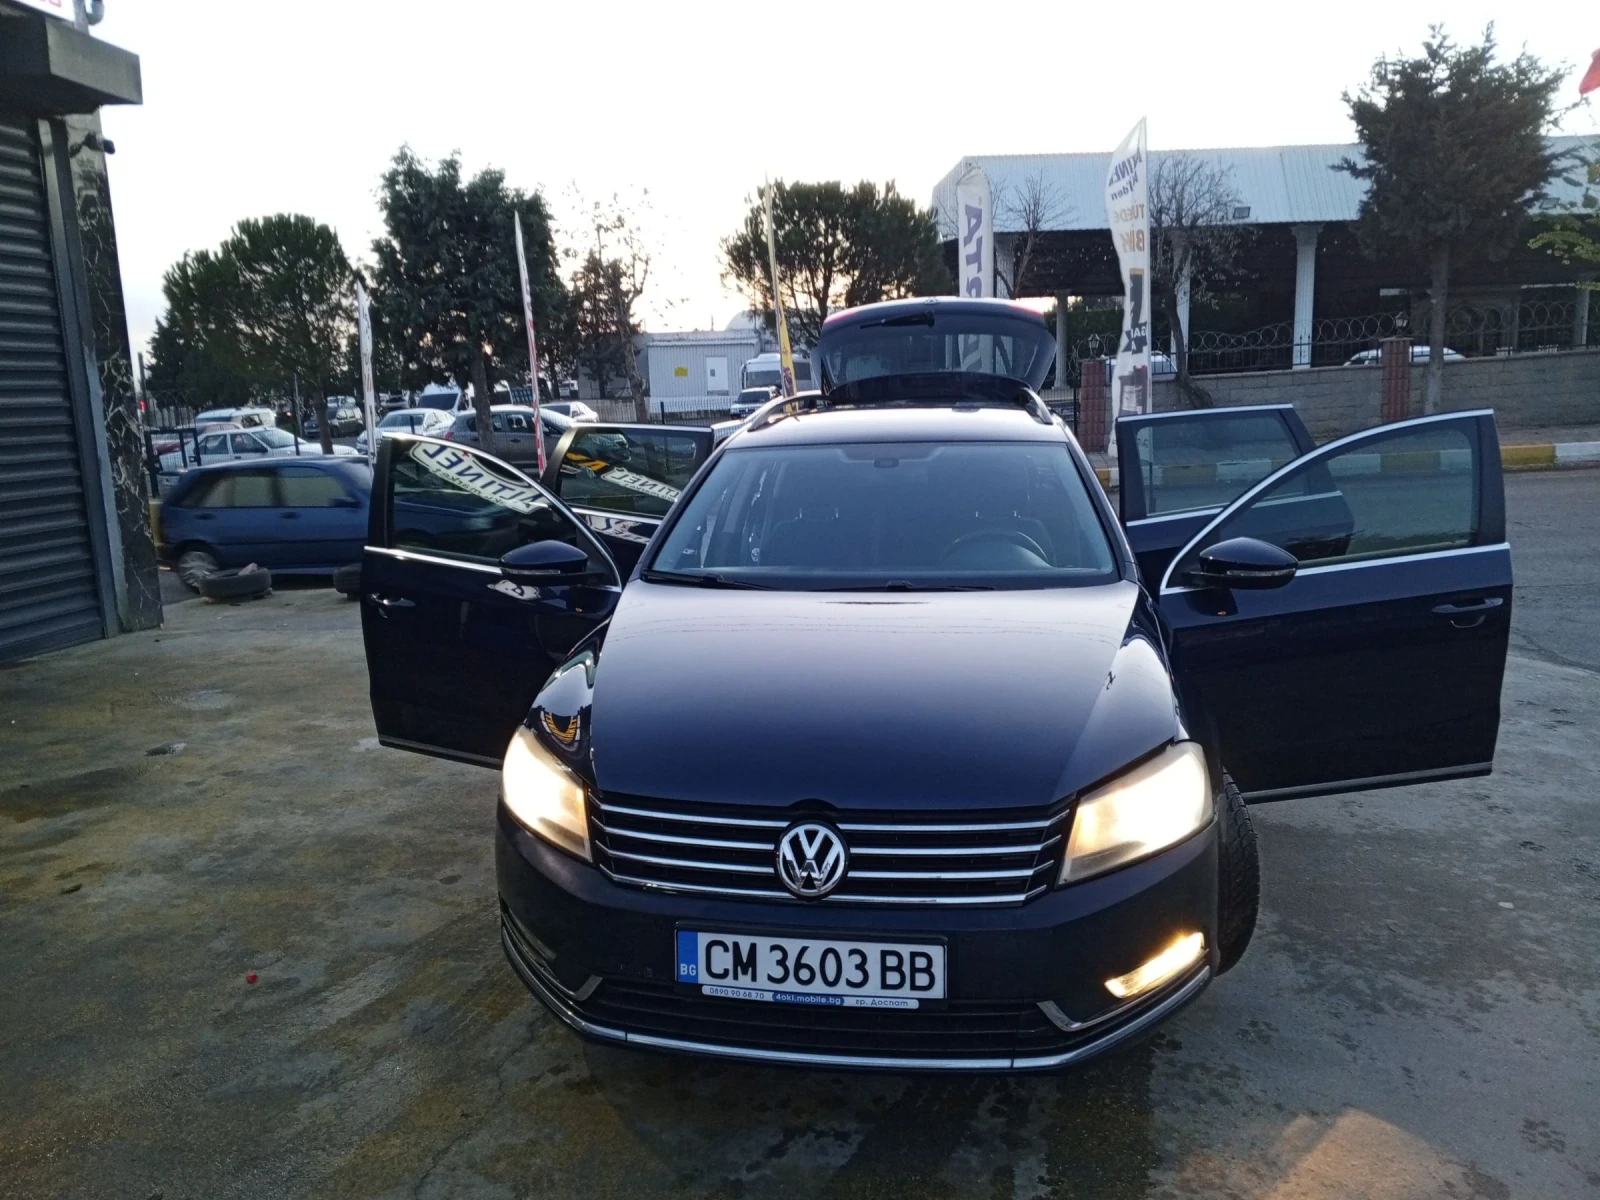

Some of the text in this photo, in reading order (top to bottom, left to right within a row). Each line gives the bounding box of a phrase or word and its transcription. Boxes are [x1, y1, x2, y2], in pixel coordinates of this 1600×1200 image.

[780, 824, 845, 896] VW
[680, 964, 697, 977] BG
[705, 939, 936, 991] CM 3603 BB
[709, 987, 729, 997] 0890
[730, 989, 741, 997] 90
